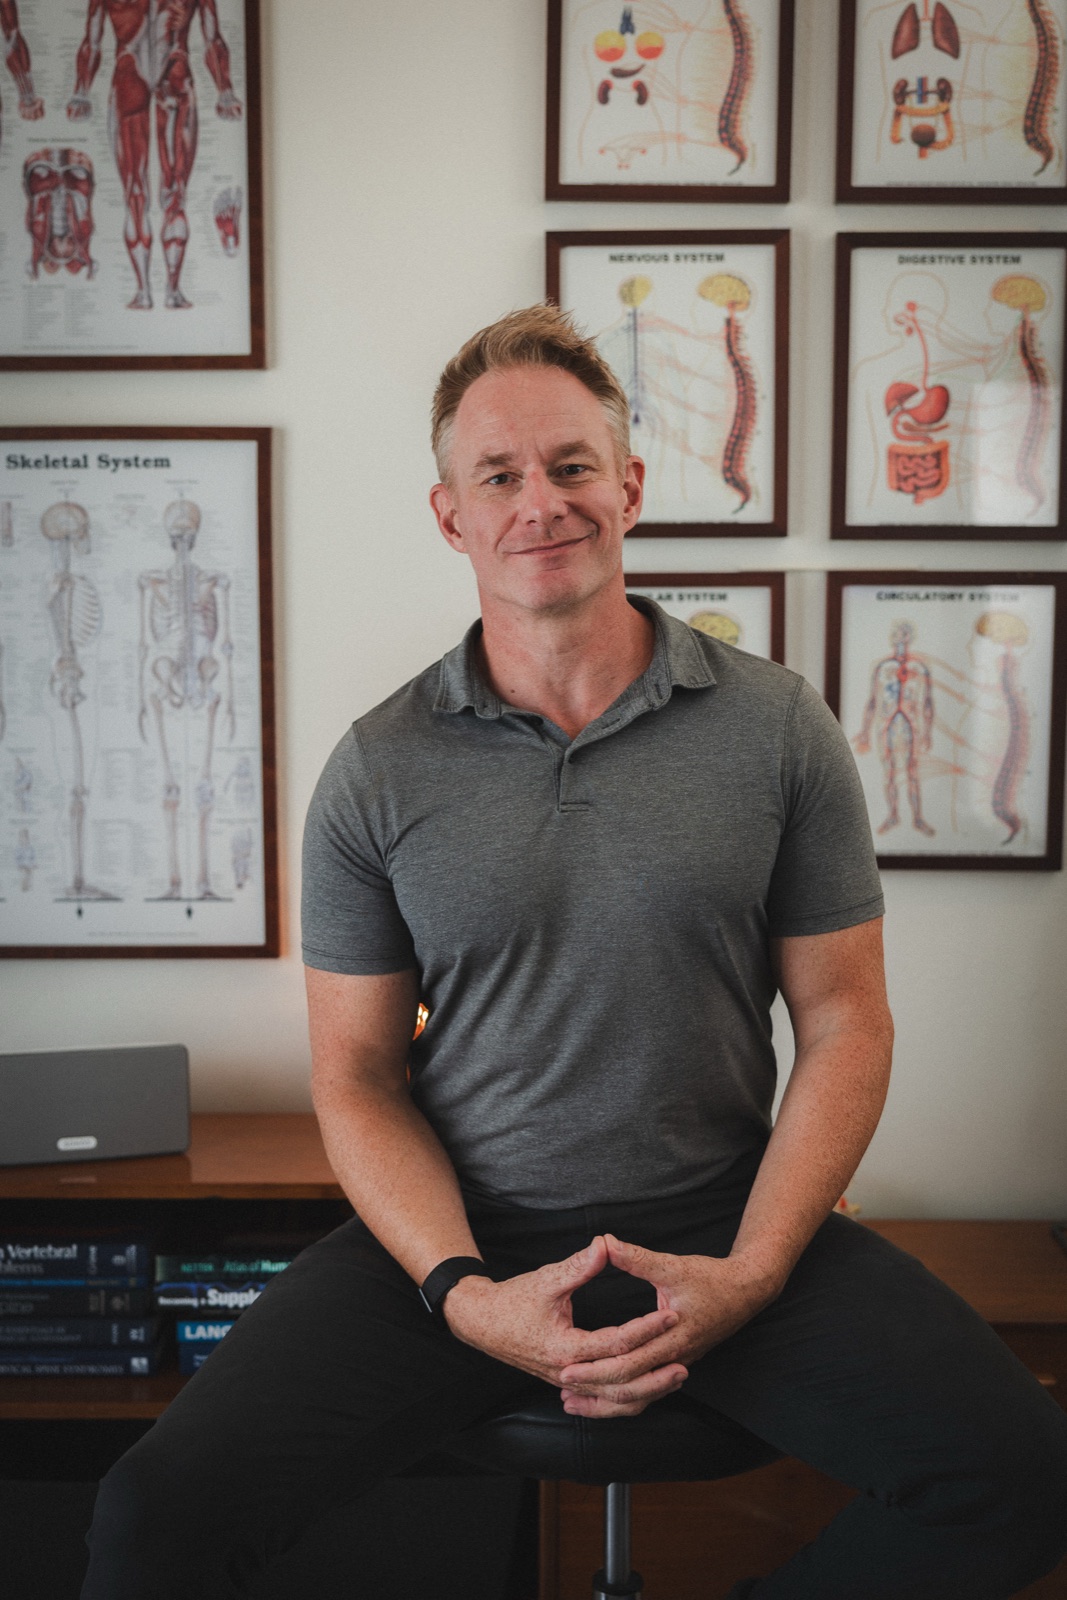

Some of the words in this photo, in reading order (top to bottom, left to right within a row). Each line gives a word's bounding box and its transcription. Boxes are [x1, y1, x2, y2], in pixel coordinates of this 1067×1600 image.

[609, 254, 669, 263] NERVOUS
[674, 253, 724, 262] SYSTEM
[898, 255, 965, 264] DIGESTIVE
[970, 255, 1021, 264] SYSTEM
[6, 454, 88, 469] Skeletal
[97, 454, 171, 473] System
[678, 592, 727, 601] SYSTEM
[877, 591, 963, 600] CIRCULATORY
[7, 1243, 77, 1259] Vertebral
